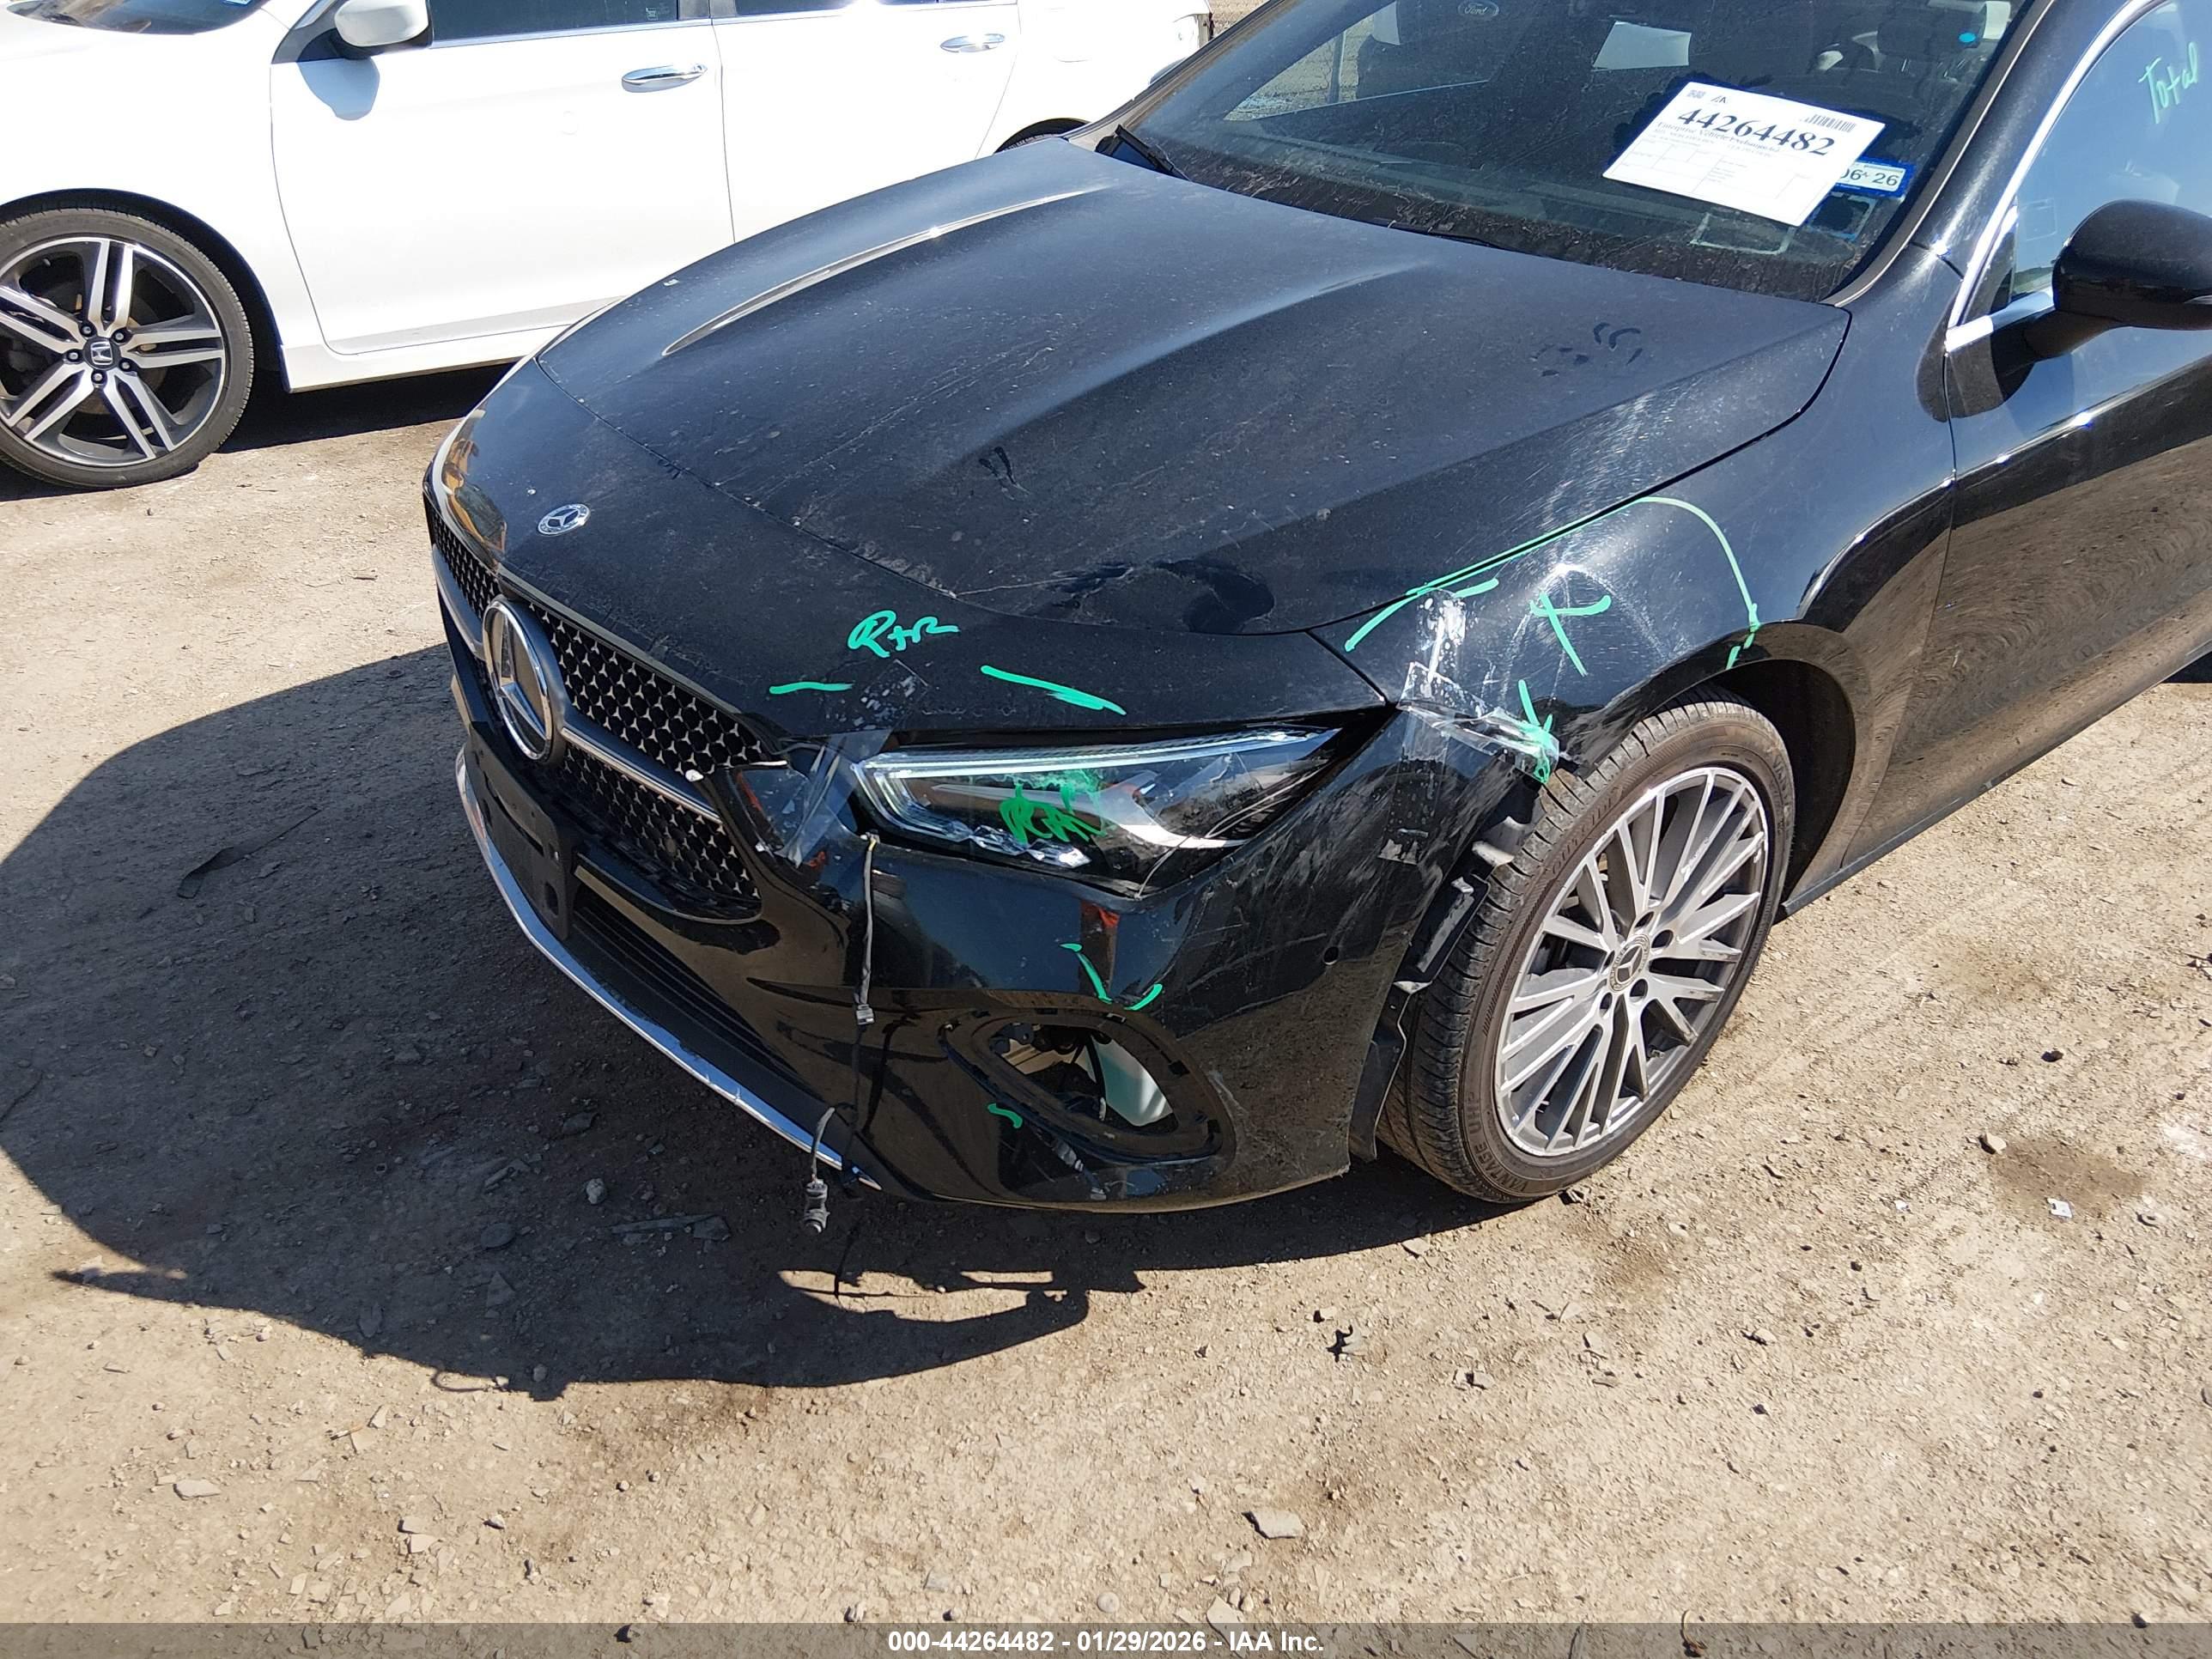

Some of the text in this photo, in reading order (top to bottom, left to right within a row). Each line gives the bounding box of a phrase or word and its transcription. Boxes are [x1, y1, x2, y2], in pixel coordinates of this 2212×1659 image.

[1678, 108, 1836, 156] 44264482
[1871, 173, 1899, 186] 26
[1474, 1141, 1528, 1192] VANTAGE
